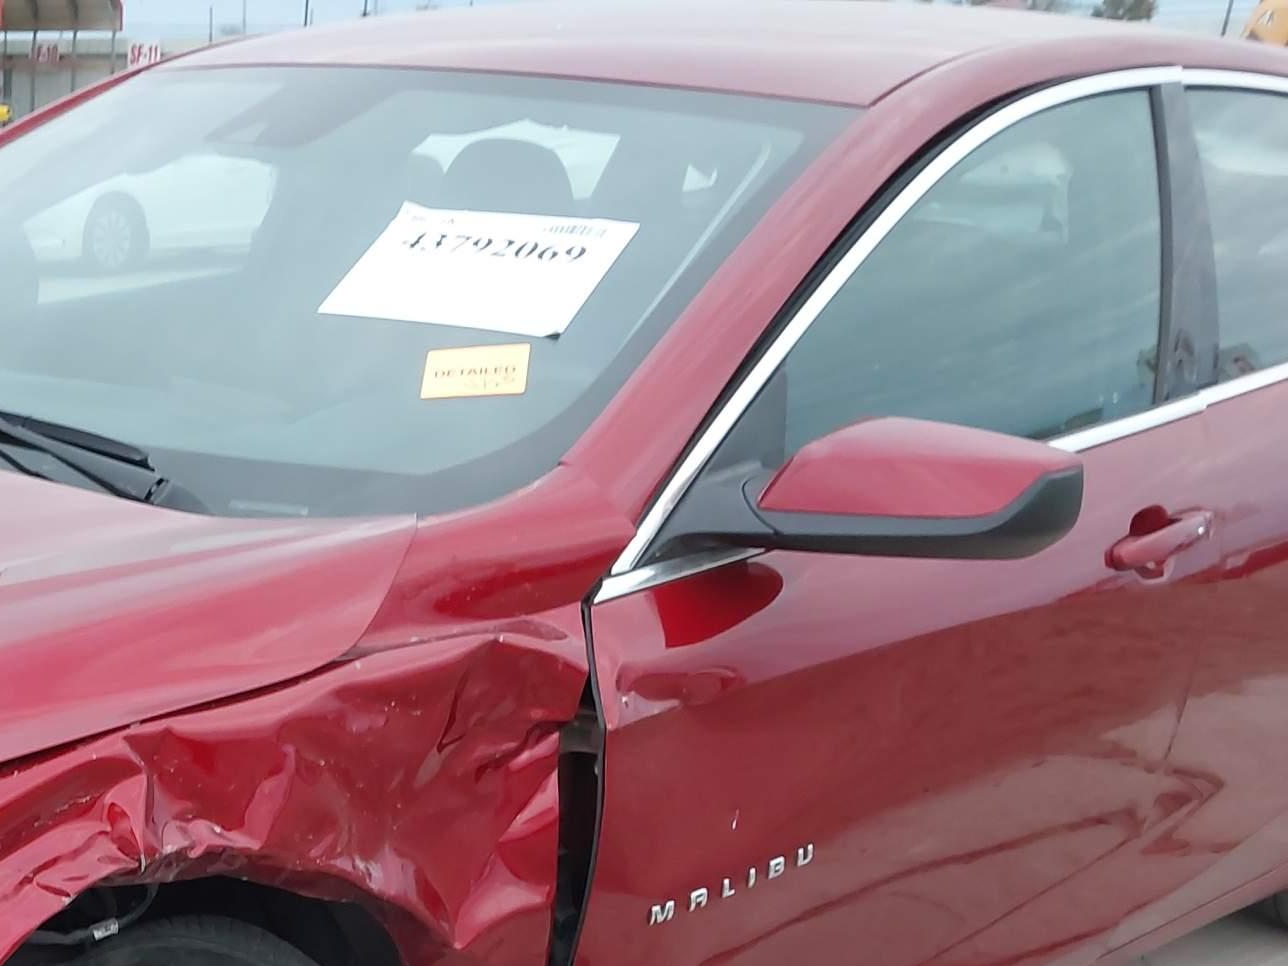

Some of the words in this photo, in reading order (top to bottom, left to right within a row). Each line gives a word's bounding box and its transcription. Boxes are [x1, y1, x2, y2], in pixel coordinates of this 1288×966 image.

[129, 43, 160, 65] SF-11
[402, 232, 587, 263] 43792069
[648, 842, 815, 927] MALIBU
